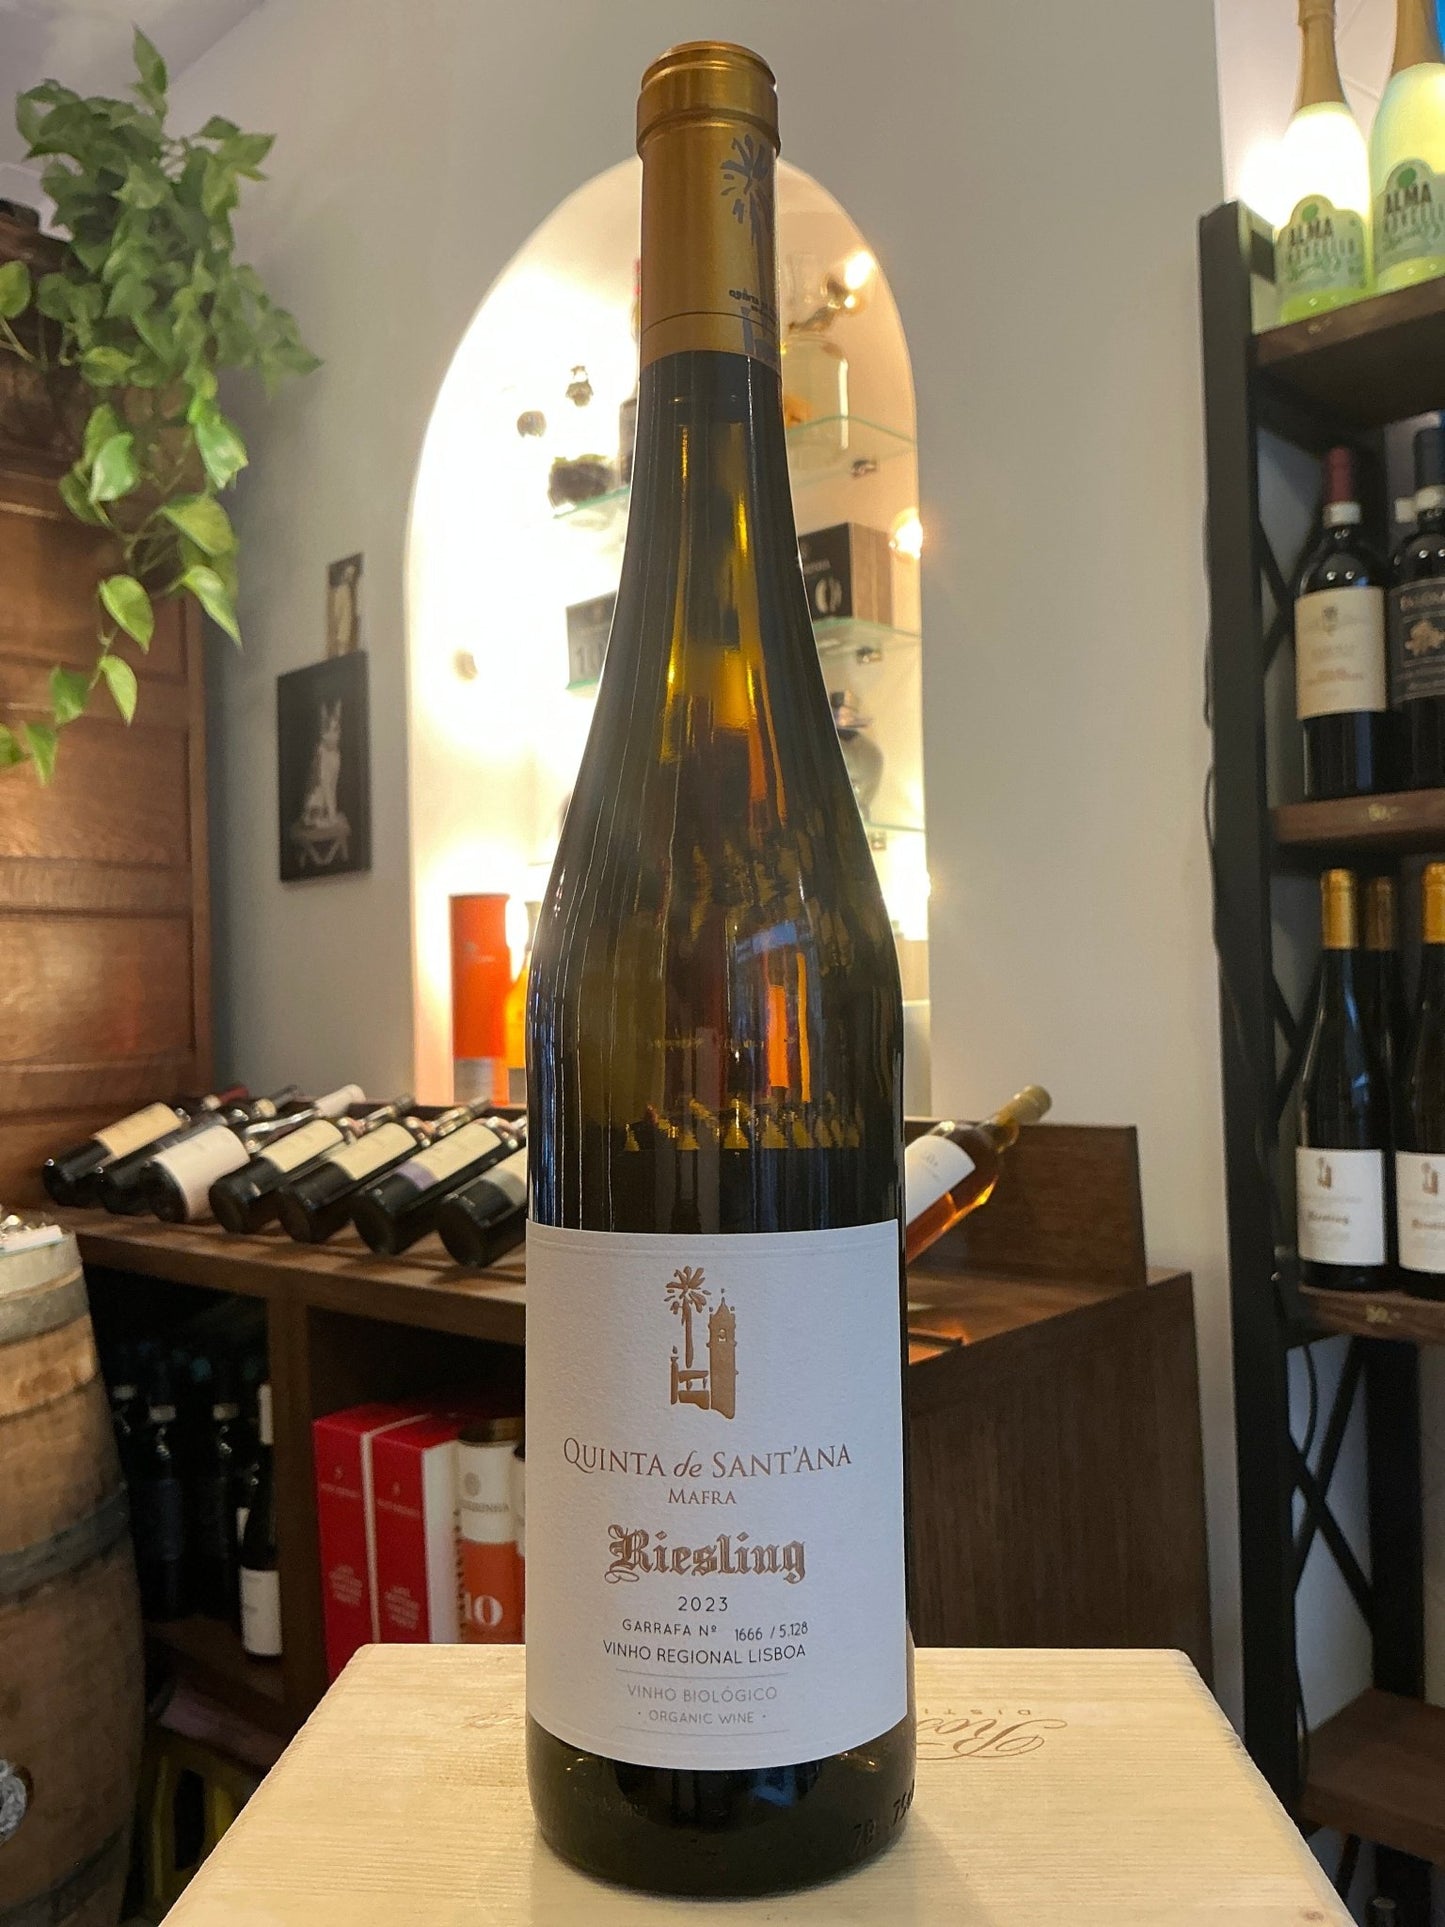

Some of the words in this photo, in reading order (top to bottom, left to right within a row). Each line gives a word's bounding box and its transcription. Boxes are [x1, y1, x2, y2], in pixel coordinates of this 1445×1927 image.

[563, 1437, 665, 1477] QUINTA
[673, 1449, 702, 1478] de
[712, 1443, 852, 1479] SANT'ANA
[667, 1487, 737, 1505] MAFRA
[604, 1524, 806, 1585] Riesling
[677, 1596, 729, 1612] 2023
[622, 1618, 692, 1637] GARRAFA
[734, 1627, 763, 1642] 1666
[603, 1640, 651, 1660] VINHO
[657, 1646, 743, 1664] REGIONAL
[748, 1644, 806, 1664] LISBOA
[627, 1684, 677, 1702] VINHO
[683, 1685, 778, 1703] BIOLÓGICO
[649, 1709, 713, 1725] ORGANIC
[718, 1711, 755, 1725] WINE
